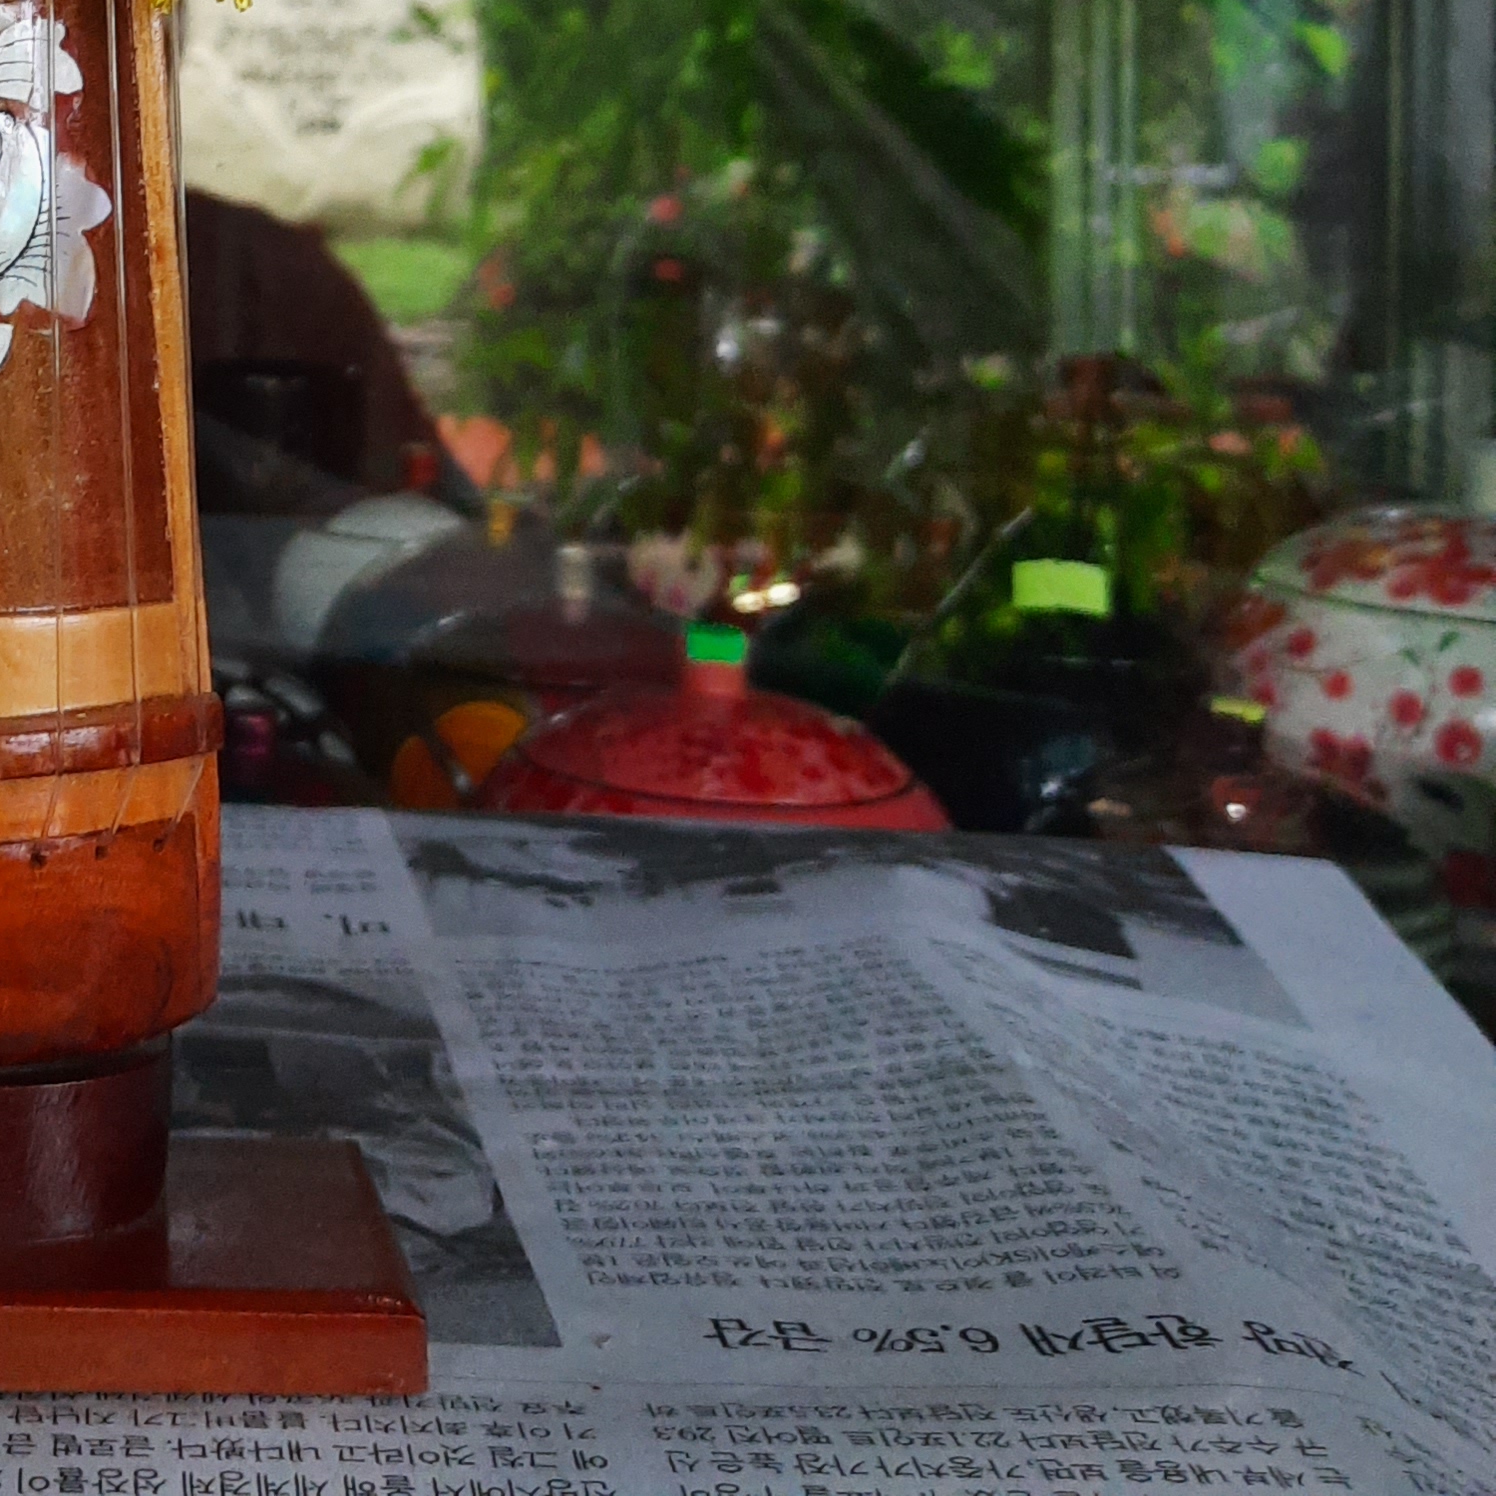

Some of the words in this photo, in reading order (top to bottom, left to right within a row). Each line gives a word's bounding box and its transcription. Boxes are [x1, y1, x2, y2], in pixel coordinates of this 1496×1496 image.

[701, 1316, 833, 1355] 급감
[851, 1323, 1000, 1354] 6.5%
[1019, 1314, 1222, 1358] 한달새
[7, 1406, 116, 1426] 지난달
[644, 1401, 678, 1419] 하
[859, 1403, 995, 1422] 전달보다
[1001, 1405, 1107, 1424] 생산도
[479, 1420, 551, 1441] 이후
[563, 1422, 595, 1441] 기
[652, 1425, 716, 1443] 29.3
[724, 1425, 831, 1446] 떨어진
[842, 1427, 1012, 1449] 22.1포인트
[1019, 1429, 1162, 1453] 전달보다
[51, 1434, 156, 1459] 글로벌
[166, 1436, 322, 1463] 내다봤다.
[332, 1443, 477, 1467] 것이라고
[1172, 1433, 1281, 1456] 수주가
[1293, 1437, 1328, 1458] 규
[487, 1445, 558, 1468] 그칠
[572, 1449, 609, 1470] 에
[663, 1448, 699, 1472] 신
[710, 1451, 783, 1475] 높은
[792, 1454, 867, 1477] 가장
[872, 1454, 1025, 1479] 가중치가
[1028, 1458, 1110, 1481] 보면,
[1115, 1459, 1229, 1485] 내용을
[1233, 1464, 1305, 1487] 세부
[1312, 1467, 1352, 1489] 는
[15, 1468, 166, 1496] 성장률이
[181, 1471, 330, 1496] 세계경제
[341, 1475, 415, 1496] 올해
